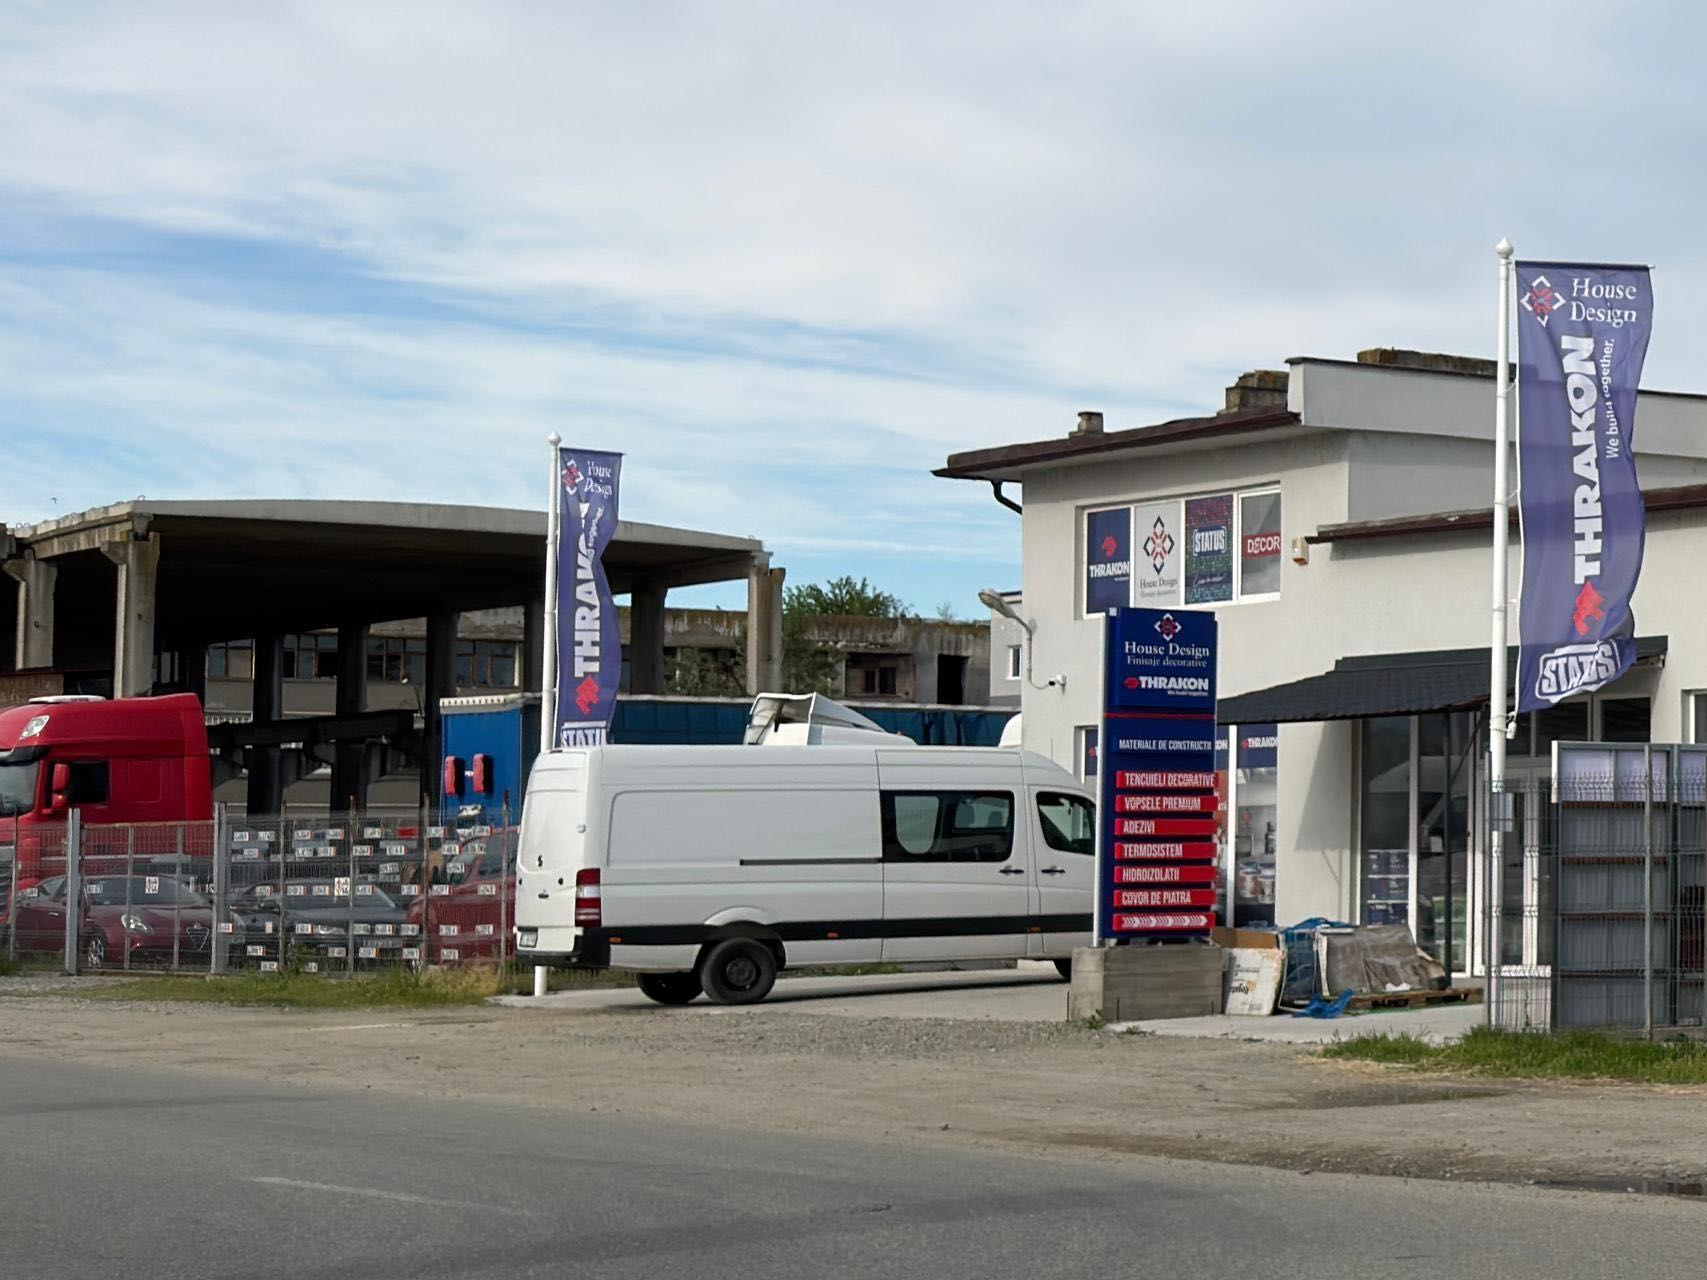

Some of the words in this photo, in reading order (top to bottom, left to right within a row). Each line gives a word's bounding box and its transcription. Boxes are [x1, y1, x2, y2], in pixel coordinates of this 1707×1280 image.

[1572, 278, 1637, 300] House
[1571, 301, 1637, 328] Design
[1605, 437, 1619, 459] We
[1561, 335, 1602, 584] THRAKON
[1195, 530, 1225, 553] STATUS
[1247, 535, 1281, 554] DECOR
[1089, 561, 1130, 578] THRAKON
[1124, 641, 1165, 655] House
[1168, 643, 1210, 659] Design
[1162, 656, 1208, 668] decorative
[1139, 676, 1209, 691] THRAKON
[1119, 739, 1156, 750] MATERIALE
[1158, 739, 1167, 750] DE
[1125, 772, 1166, 787] TENCUIELI
[1167, 772, 1216, 788] DECORATIVE
[1124, 796, 1161, 811] VOPSELE
[1162, 796, 1201, 811] PREMIUM
[1123, 820, 1155, 834] ADEZIVI
[1123, 843, 1184, 858] TERMOSISTEM
[1122, 891, 1149, 906] COVOR
[1150, 891, 1161, 905] DE
[1163, 890, 1192, 905] PIATRA
